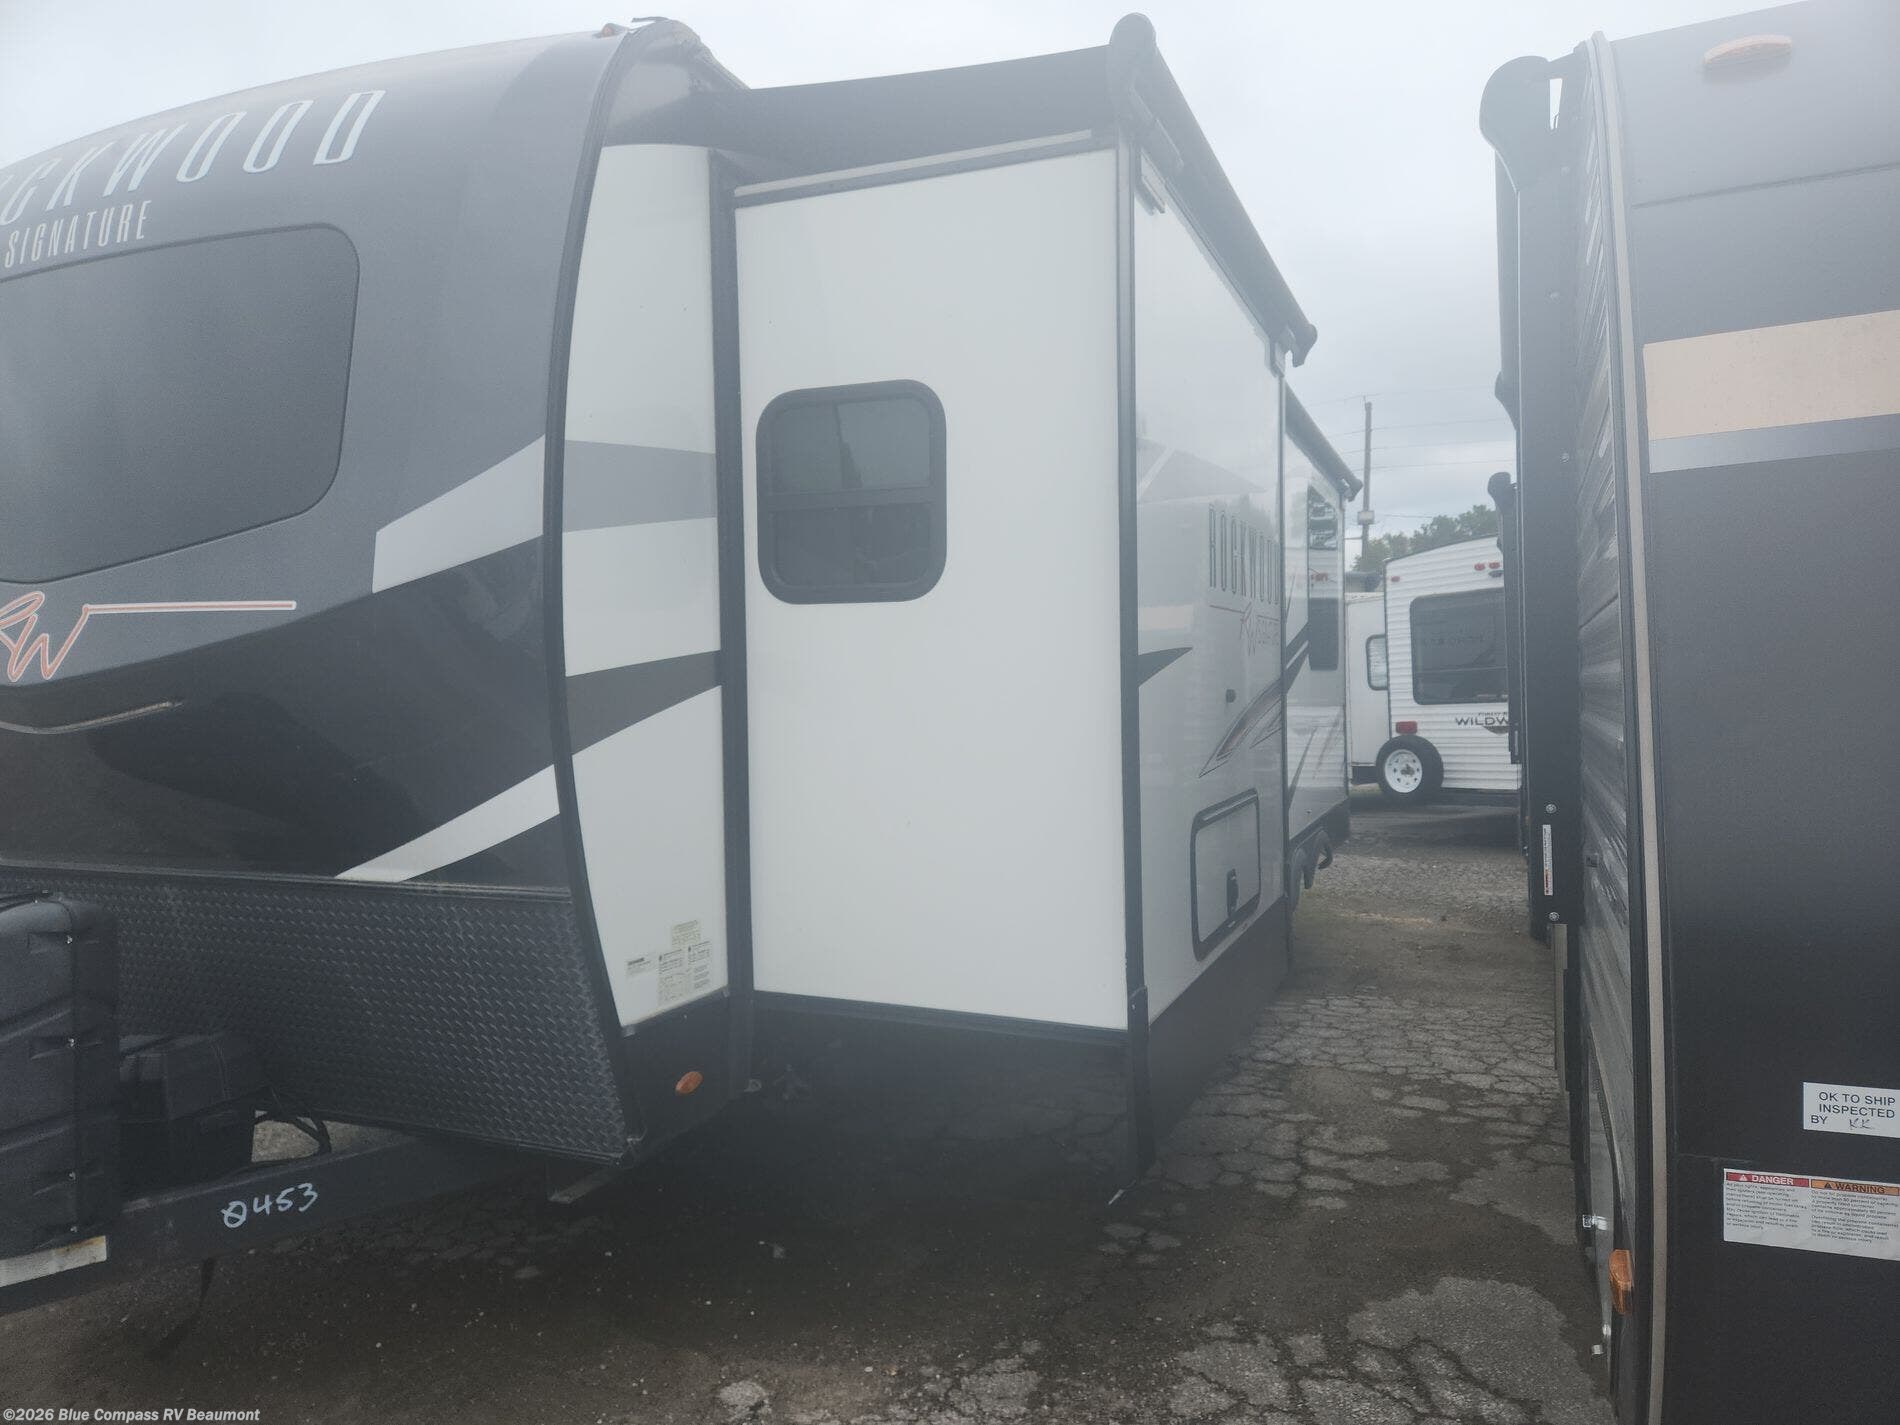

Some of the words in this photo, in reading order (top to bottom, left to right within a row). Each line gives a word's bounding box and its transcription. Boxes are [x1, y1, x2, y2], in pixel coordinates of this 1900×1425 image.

[0, 89, 386, 226] CKWOOD
[4, 200, 152, 268] SIGNATURE
[1818, 1091, 1838, 1102] OK
[1842, 1093, 1860, 1103] TO
[1864, 1095, 1896, 1106] SHIP
[1819, 1103, 1895, 1118] INSPECTED
[1810, 1114, 1828, 1125] BY
[1751, 1174, 1794, 1186] DANGER
[1835, 1181, 1885, 1194] WARNING
